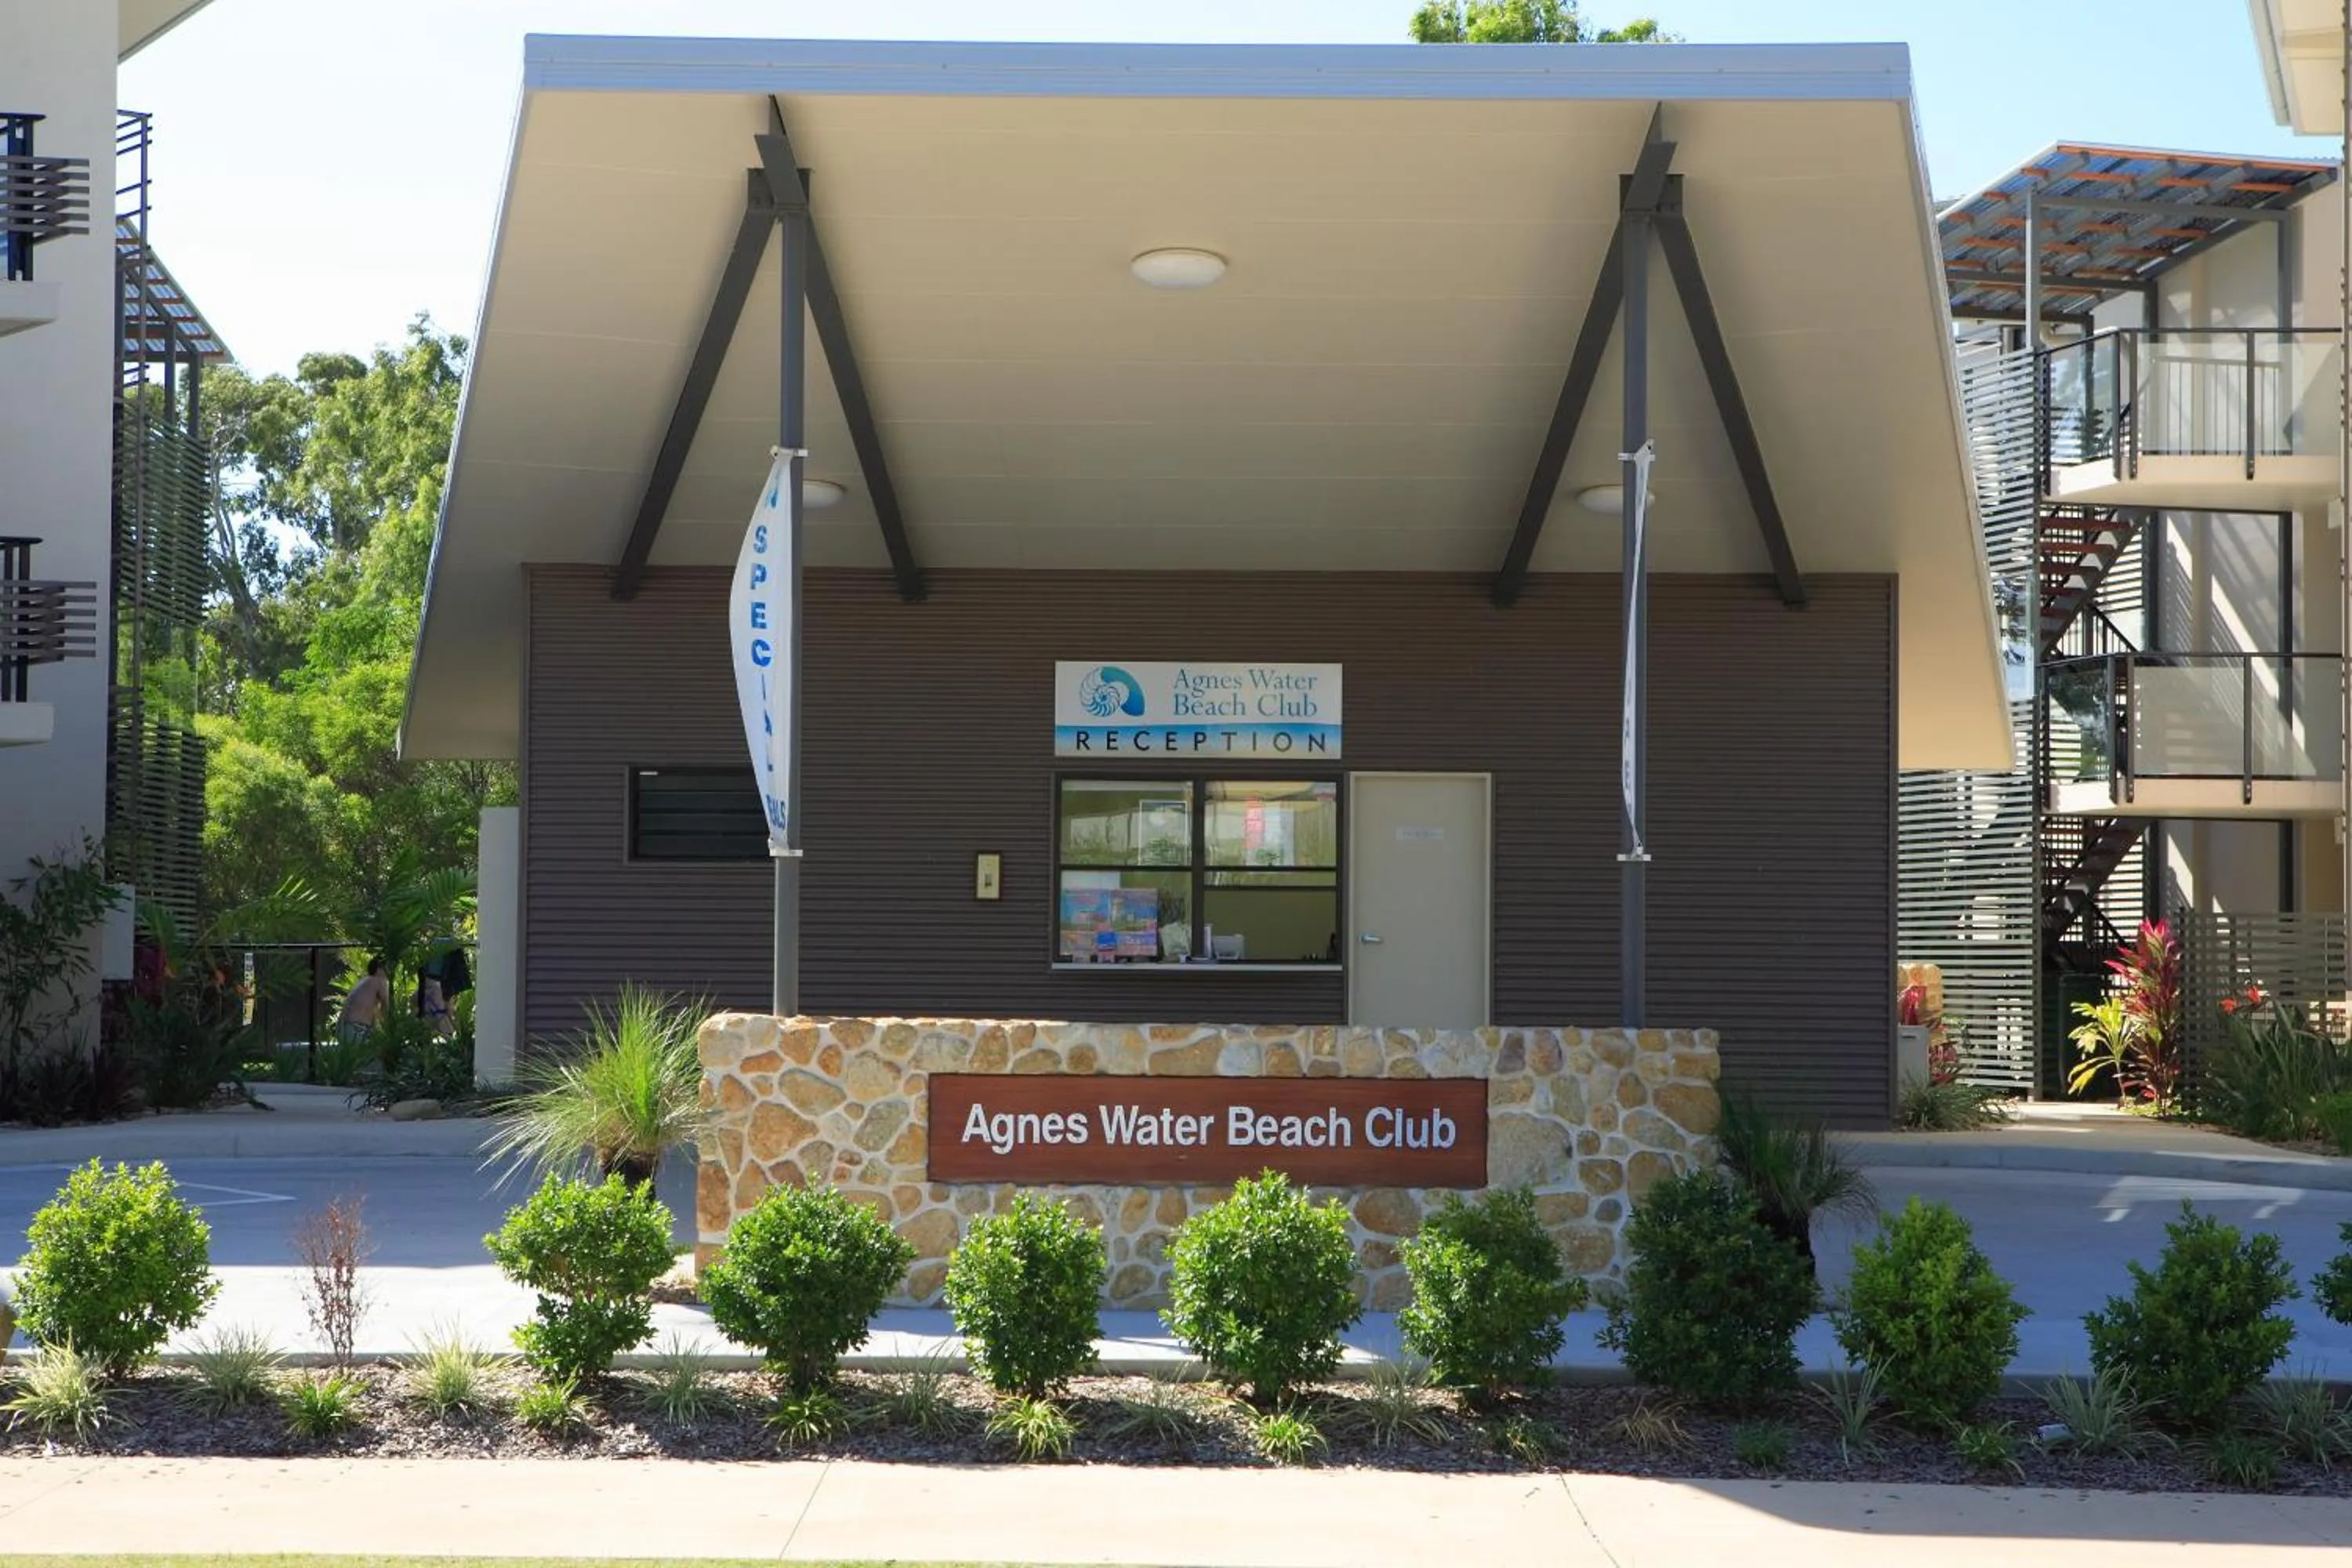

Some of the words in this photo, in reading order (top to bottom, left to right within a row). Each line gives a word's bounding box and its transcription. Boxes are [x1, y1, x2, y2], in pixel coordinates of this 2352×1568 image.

[1173, 668, 1243, 699] Agnes
[1248, 669, 1318, 691] Water
[1173, 693, 1246, 716] Beach
[1257, 694, 1318, 717] Club
[1076, 731, 1326, 753] RECEPTION
[961, 1102, 1088, 1154] Agnes
[1098, 1104, 1214, 1145] Water
[1227, 1105, 1351, 1146] Beach
[1364, 1106, 1456, 1149] Club
